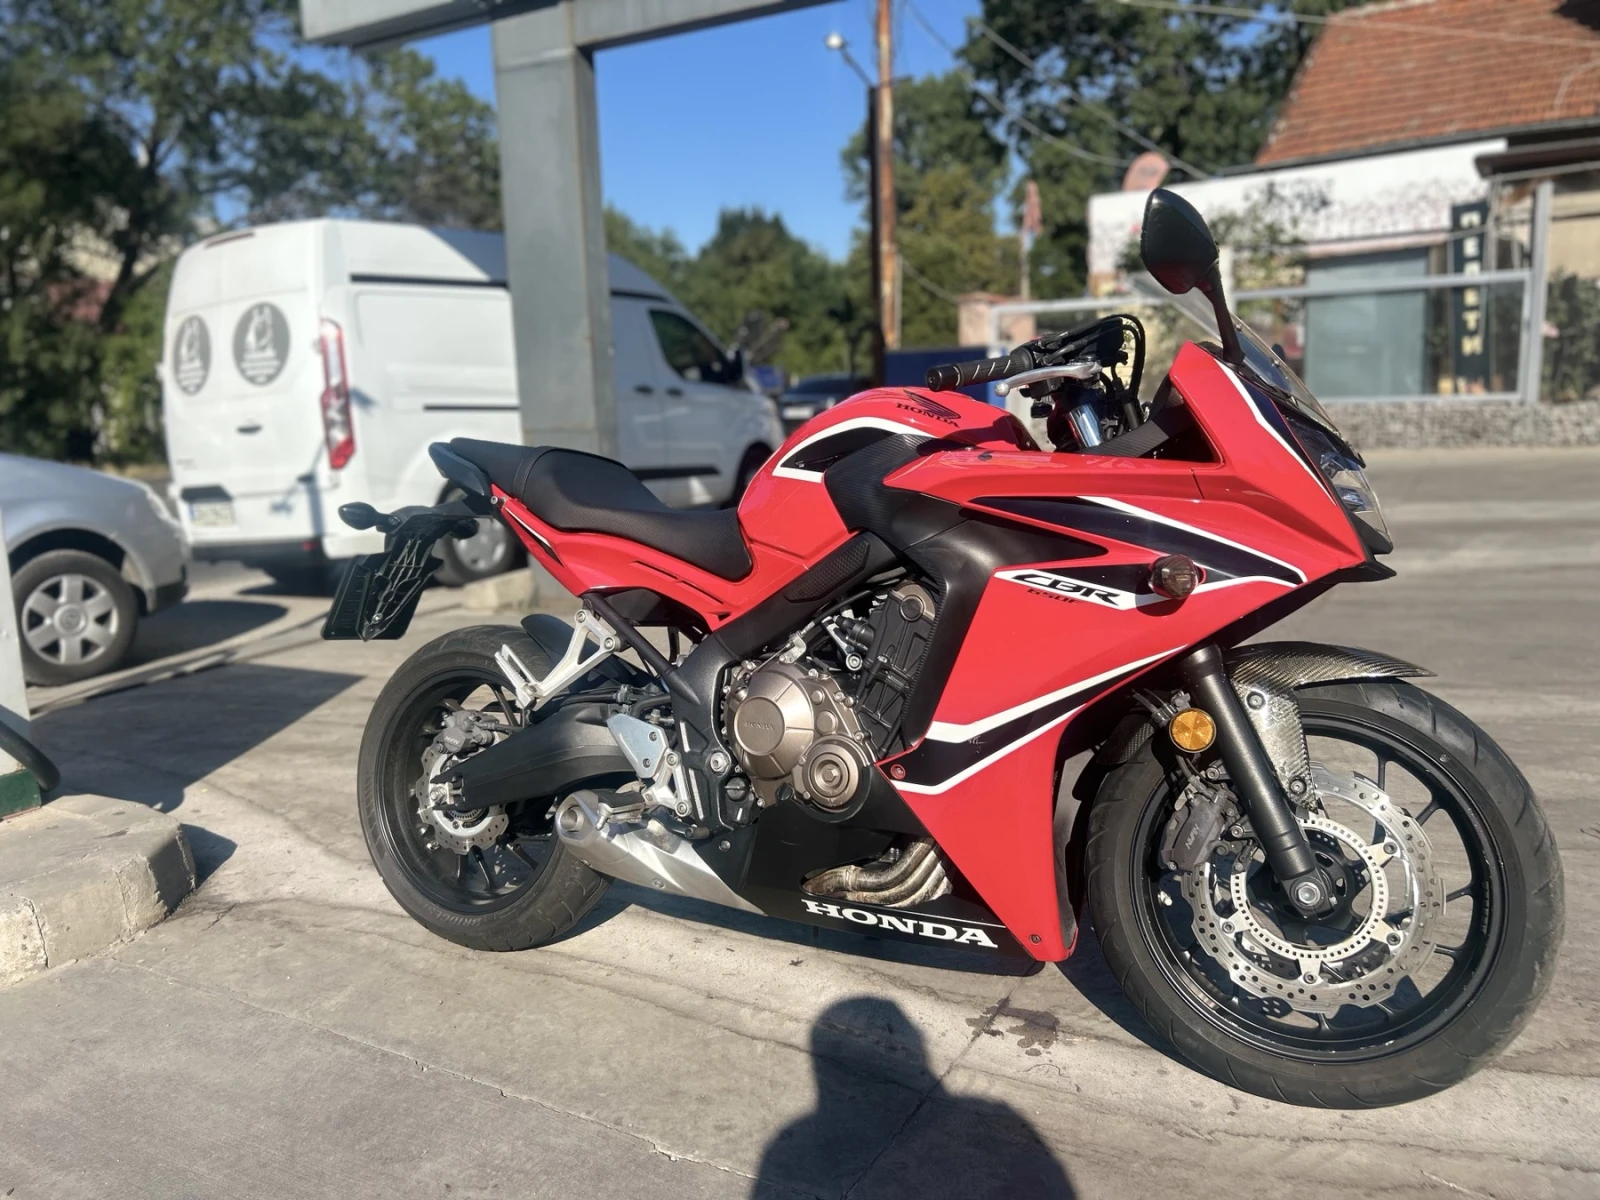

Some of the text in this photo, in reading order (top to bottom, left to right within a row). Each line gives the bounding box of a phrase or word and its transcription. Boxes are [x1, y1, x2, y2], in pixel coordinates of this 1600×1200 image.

[896, 402, 960, 428] HONDA
[1012, 573, 1120, 607] CBR
[1027, 587, 1083, 604] 650F
[744, 720, 776, 732] HONDA
[801, 899, 998, 949] HONDA
